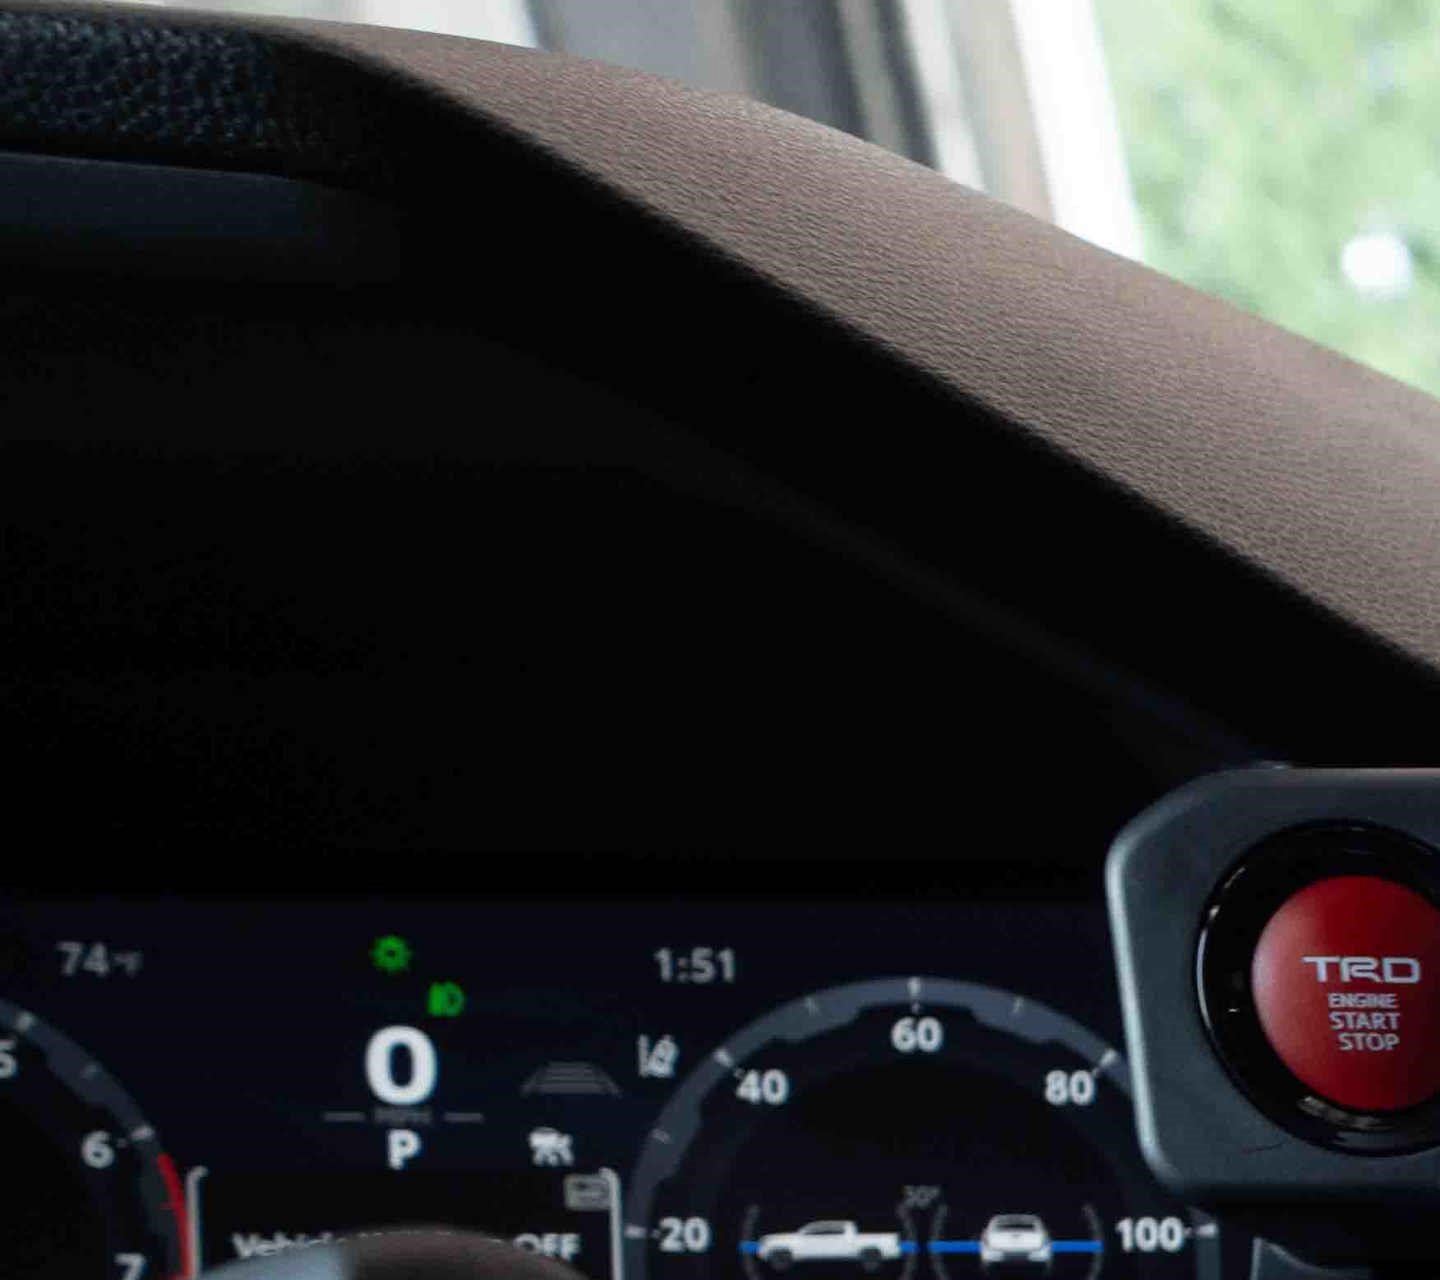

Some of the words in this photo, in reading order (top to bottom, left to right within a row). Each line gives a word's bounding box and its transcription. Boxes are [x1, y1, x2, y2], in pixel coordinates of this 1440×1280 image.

[654, 946, 736, 984] 1:51
[1301, 955, 1422, 984] TRD
[1327, 992, 1399, 1009] ENGINE
[890, 1017, 944, 1053] 60
[1328, 1011, 1401, 1030] START
[1338, 1031, 1400, 1052] STOP
[363, 1025, 438, 1106] 0
[735, 1068, 790, 1105] 40
[1044, 1068, 1098, 1105] 80
[81, 1130, 115, 1170] 6
[387, 1128, 422, 1170] P
[512, 1232, 580, 1261] OFF
[659, 1216, 711, 1253] 20
[1116, 1216, 1185, 1253] 100
